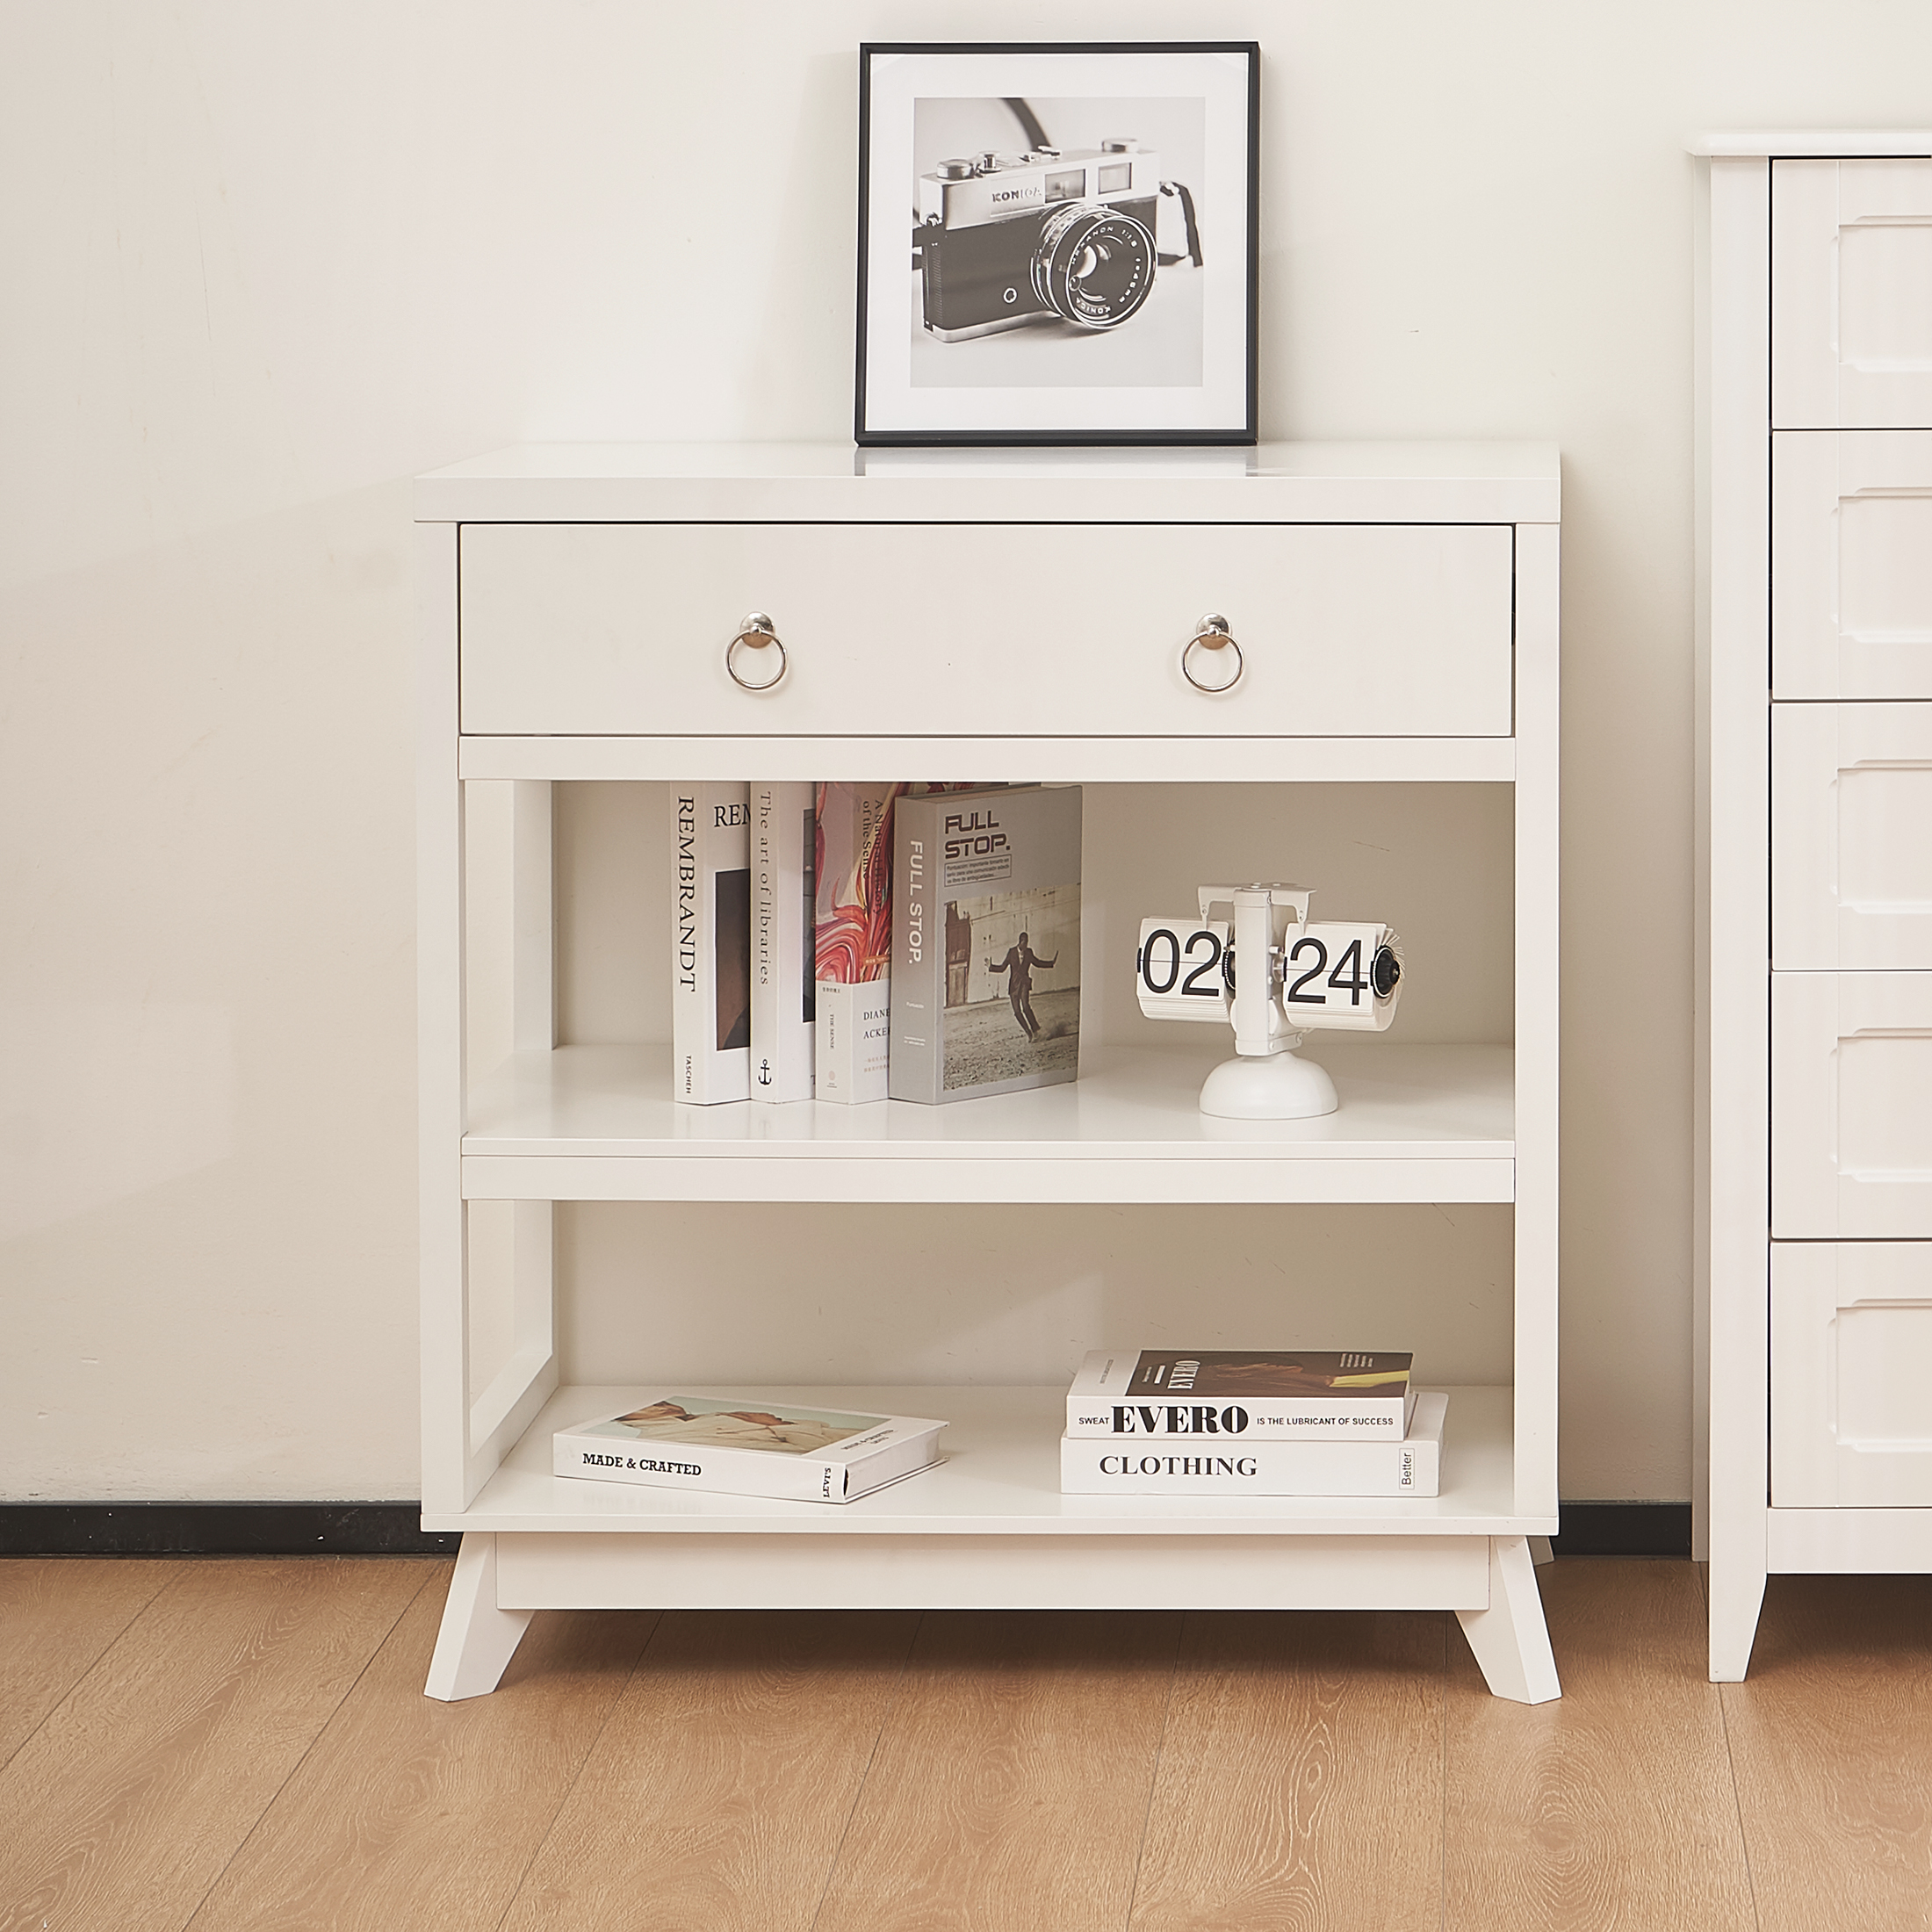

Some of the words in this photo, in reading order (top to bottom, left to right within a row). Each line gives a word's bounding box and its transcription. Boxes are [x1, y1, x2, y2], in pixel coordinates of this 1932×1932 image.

[761, 791, 771, 829] The
[862, 800, 872, 817] of
[945, 811, 999, 834] FULL
[862, 817, 872, 838] the
[945, 833, 1011, 859] STOP.
[910, 840, 923, 896] FULL
[678, 796, 696, 992] REMBRANDT
[761, 873, 772, 896] of
[761, 901, 771, 984] libraries
[909, 903, 923, 964] STOP.
[1143, 929, 1222, 997] 02
[1287, 938, 1368, 1006] 24
[1111, 1405, 1249, 1433] EVERO
[582, 1453, 624, 1467] MADE
[626, 1458, 637, 1469] &
[639, 1459, 702, 1476] CRAFTED
[1099, 1455, 1258, 1476] CLOTHING
[1402, 1453, 1411, 1485] Better
